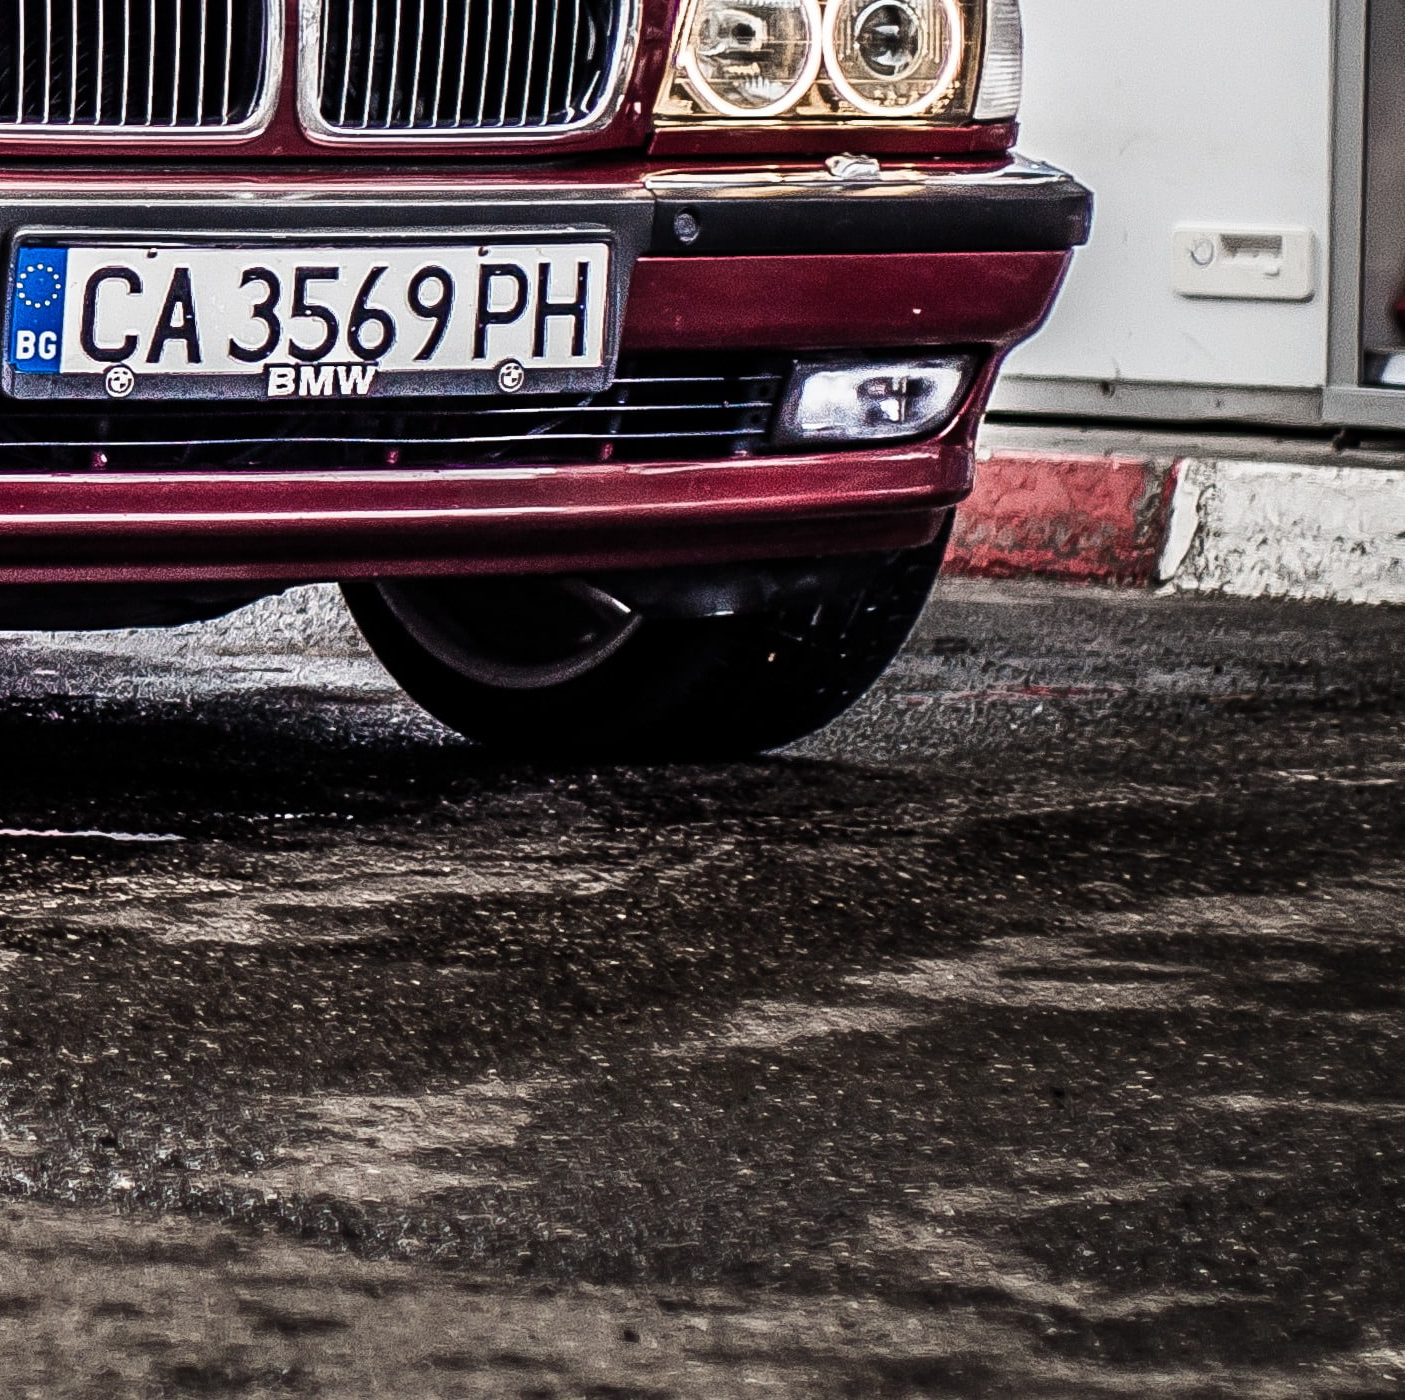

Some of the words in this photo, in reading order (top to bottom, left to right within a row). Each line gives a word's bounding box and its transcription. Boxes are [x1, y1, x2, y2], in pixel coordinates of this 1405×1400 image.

[80, 265, 203, 365] CA
[227, 264, 456, 364] 3569
[471, 260, 591, 361] PH
[15, 329, 58, 360] BG
[266, 364, 378, 397] BMW
